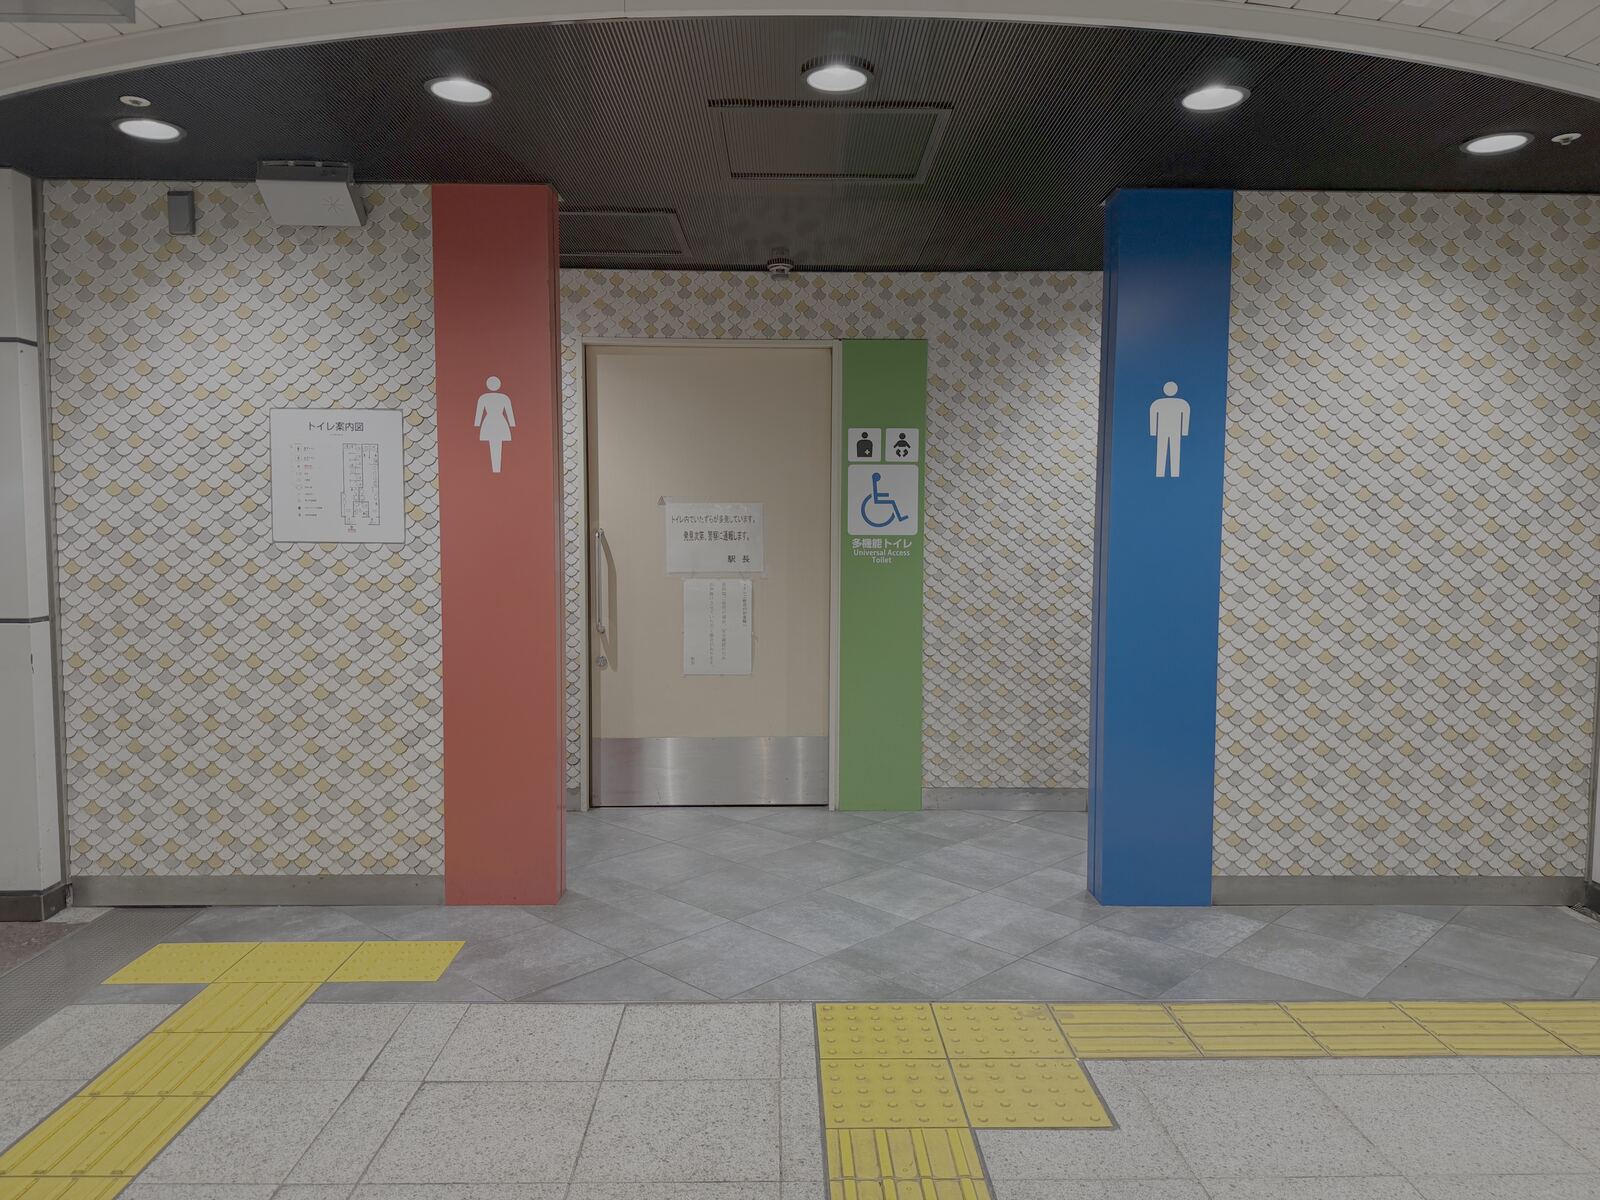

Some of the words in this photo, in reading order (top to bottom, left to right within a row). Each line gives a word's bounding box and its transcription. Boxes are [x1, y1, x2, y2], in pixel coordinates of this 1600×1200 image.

[308, 421, 364, 432] トイレ案内図
[851, 538, 912, 549] 多機能トイレ
